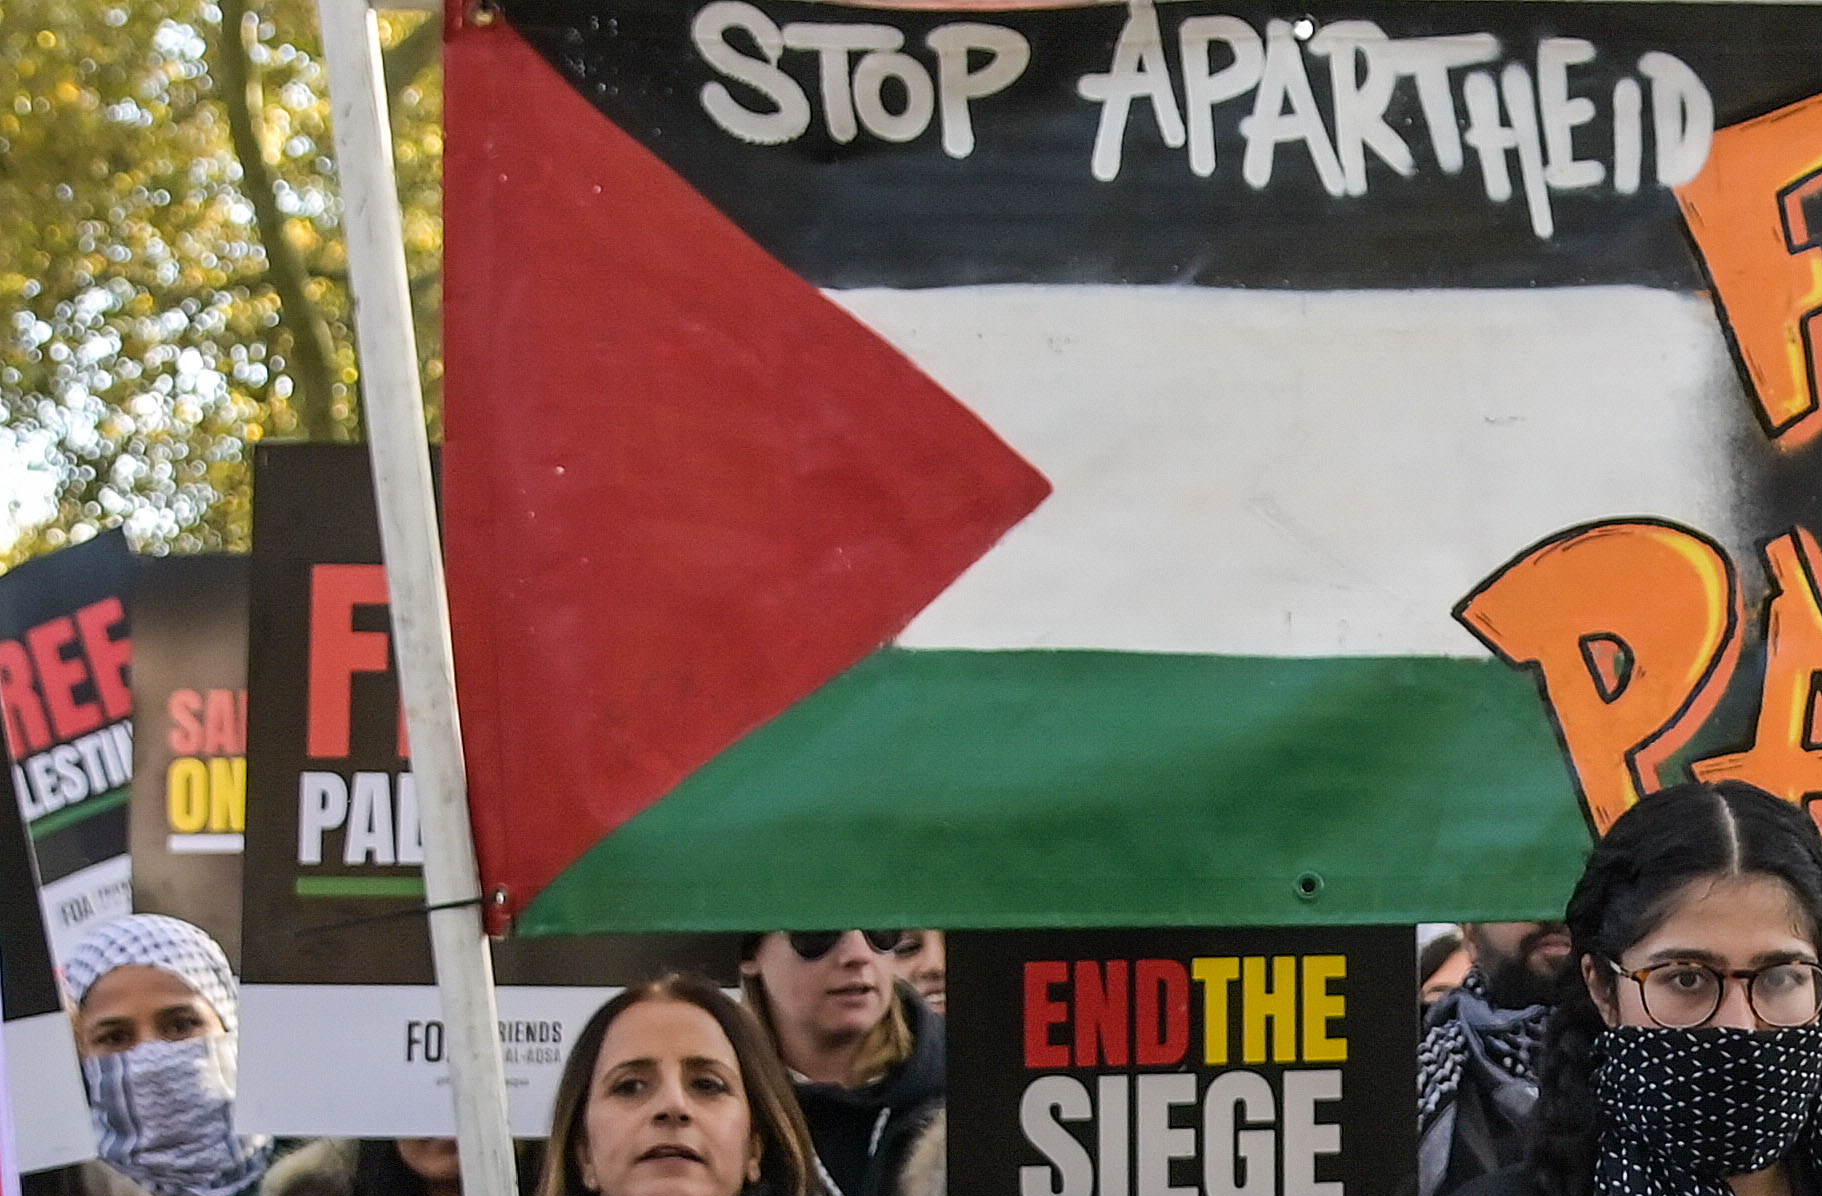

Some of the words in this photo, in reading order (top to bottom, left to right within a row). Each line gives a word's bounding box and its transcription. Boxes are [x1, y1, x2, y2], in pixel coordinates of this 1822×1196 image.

[691, 1, 1030, 158] STOP
[1078, 0, 1714, 238] APARTHEID
[407, 1020, 450, 1062] FO
[1025, 959, 1190, 1067] END
[1191, 955, 1347, 1064] THE
